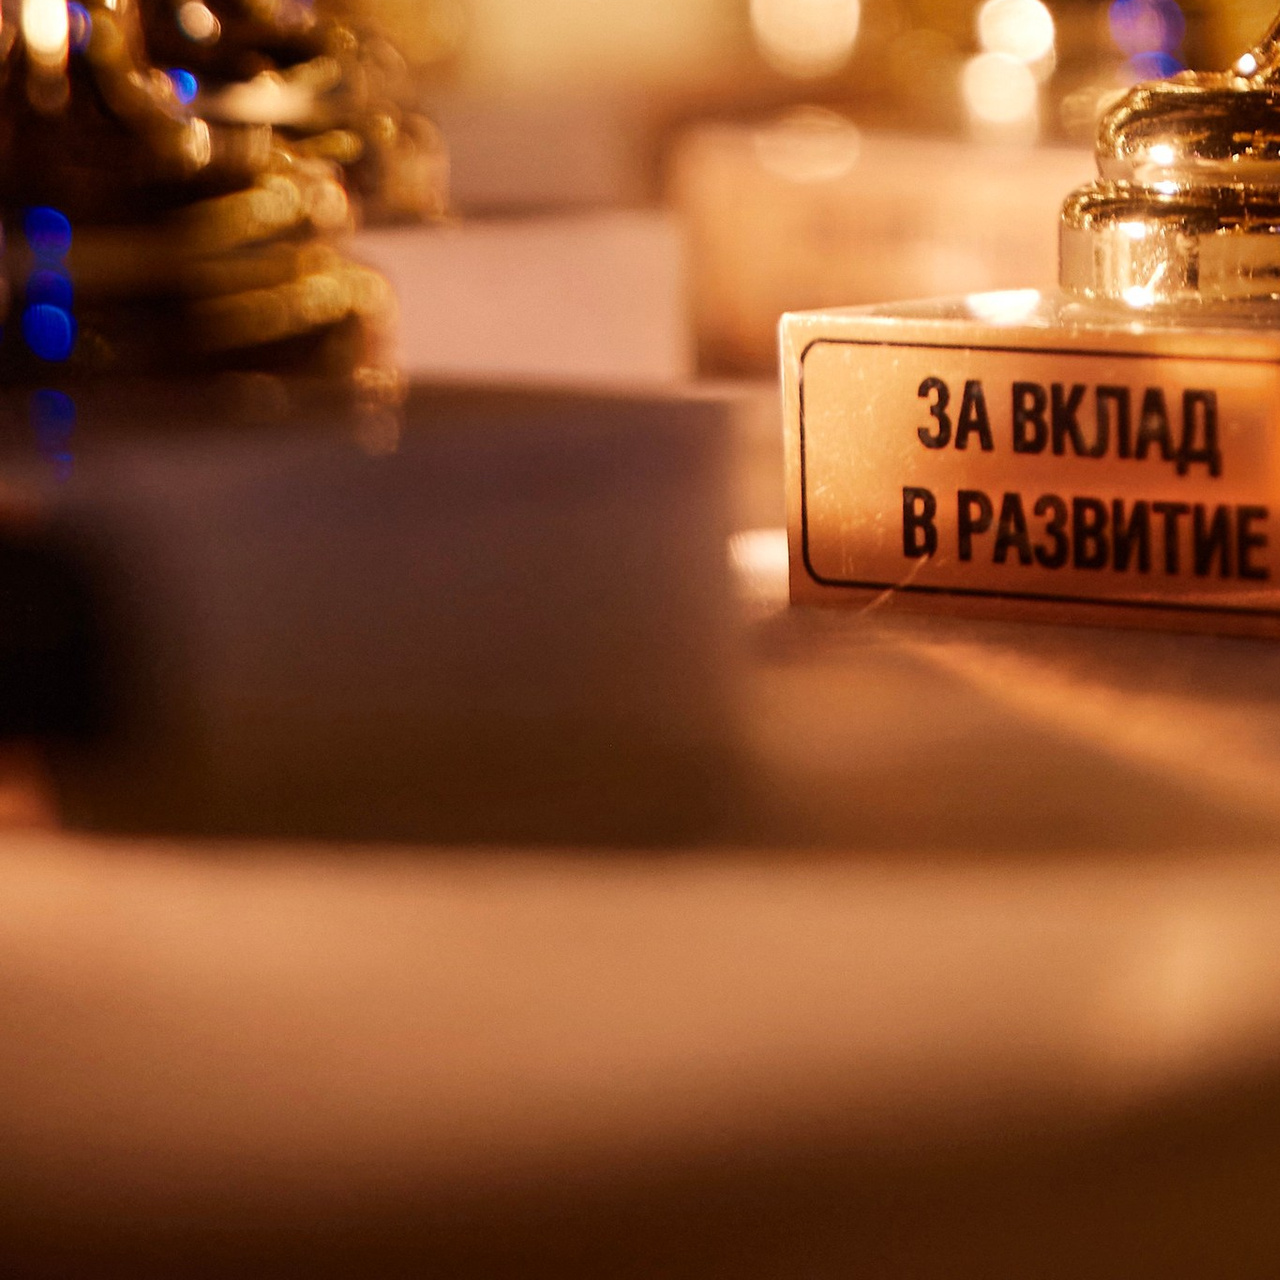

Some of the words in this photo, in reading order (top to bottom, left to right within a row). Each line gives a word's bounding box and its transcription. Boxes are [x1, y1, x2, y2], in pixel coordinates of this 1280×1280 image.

[917, 376, 993, 452] ЗА
[1011, 381, 1222, 478] ВКЛАД
[902, 486, 938, 559] В
[956, 489, 1270, 582] РАЗВИТИЕ
